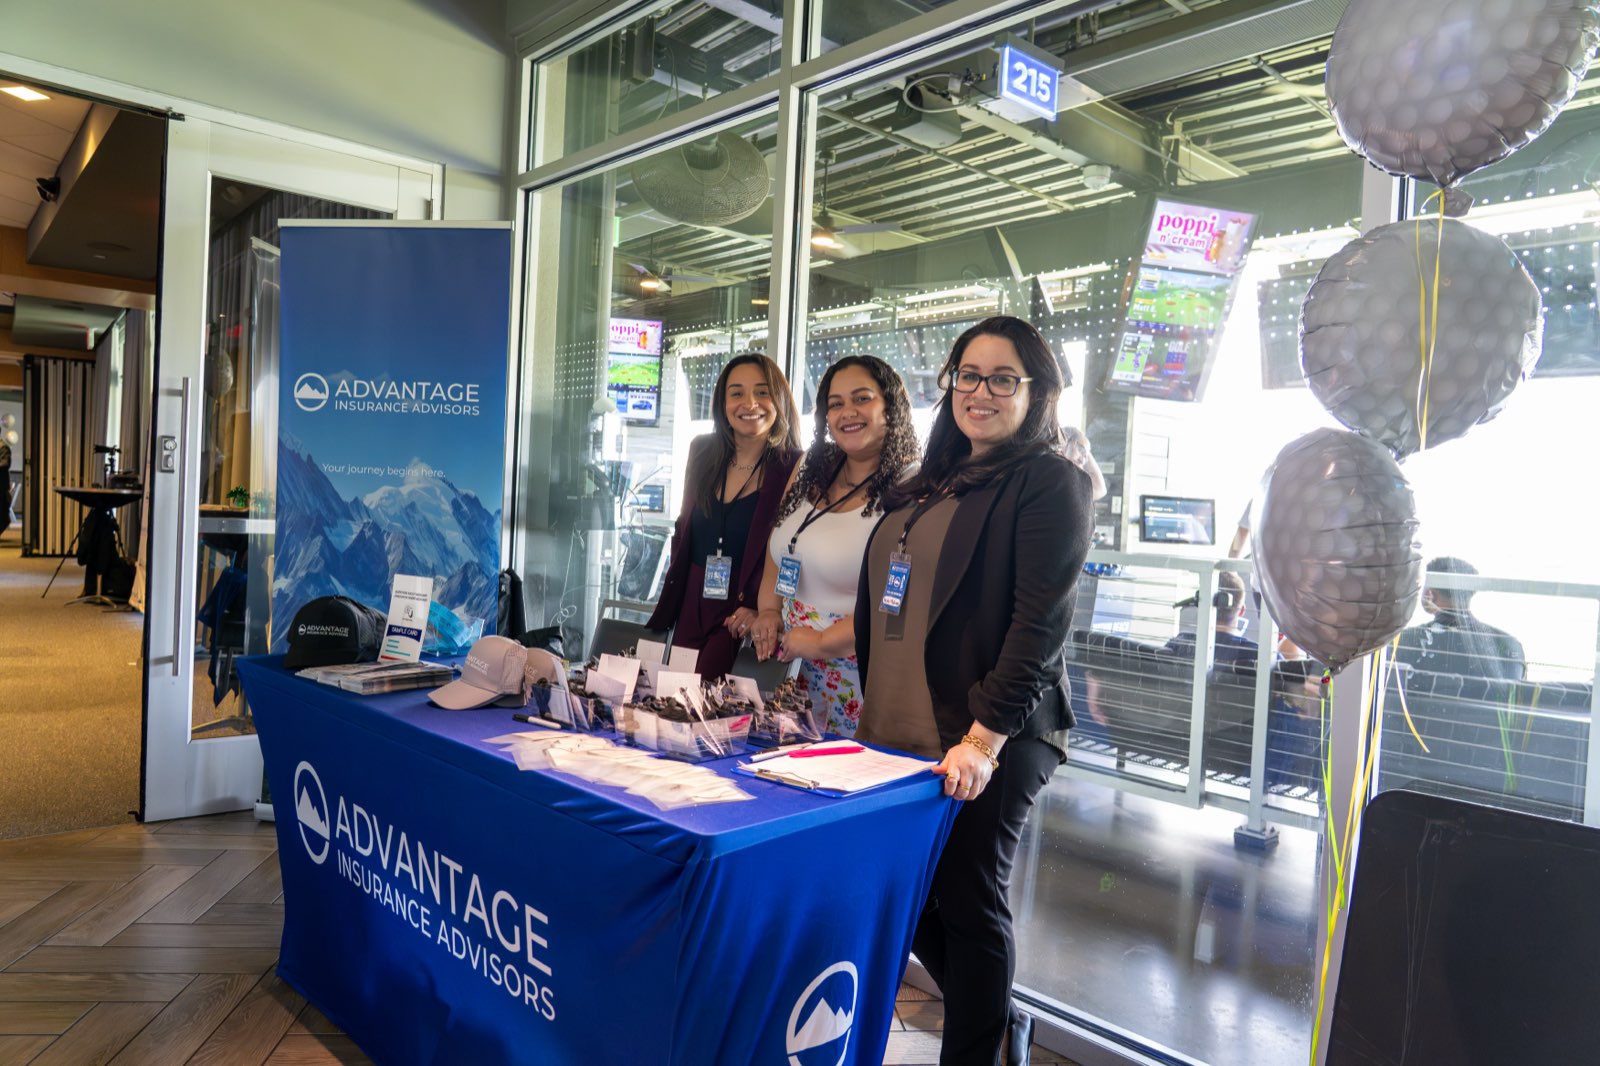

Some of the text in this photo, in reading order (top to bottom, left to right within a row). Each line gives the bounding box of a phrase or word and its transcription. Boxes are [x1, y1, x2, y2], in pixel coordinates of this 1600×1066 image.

[1013, 61, 1051, 102] 215
[1157, 214, 1217, 236] poppi
[1172, 236, 1206, 248] cream
[609, 323, 639, 335] oppi
[335, 379, 480, 403] ADVANTAGE
[335, 400, 480, 416] INSURANCE ADVISORS
[322, 463, 446, 478] Your journey begins here.
[307, 624, 349, 634] ADVANTAGE
[391, 626, 407, 635] SAMPLE
[336, 795, 552, 977] ADVANTAGE
[338, 849, 556, 1021] INSURANCE ADVISORS
